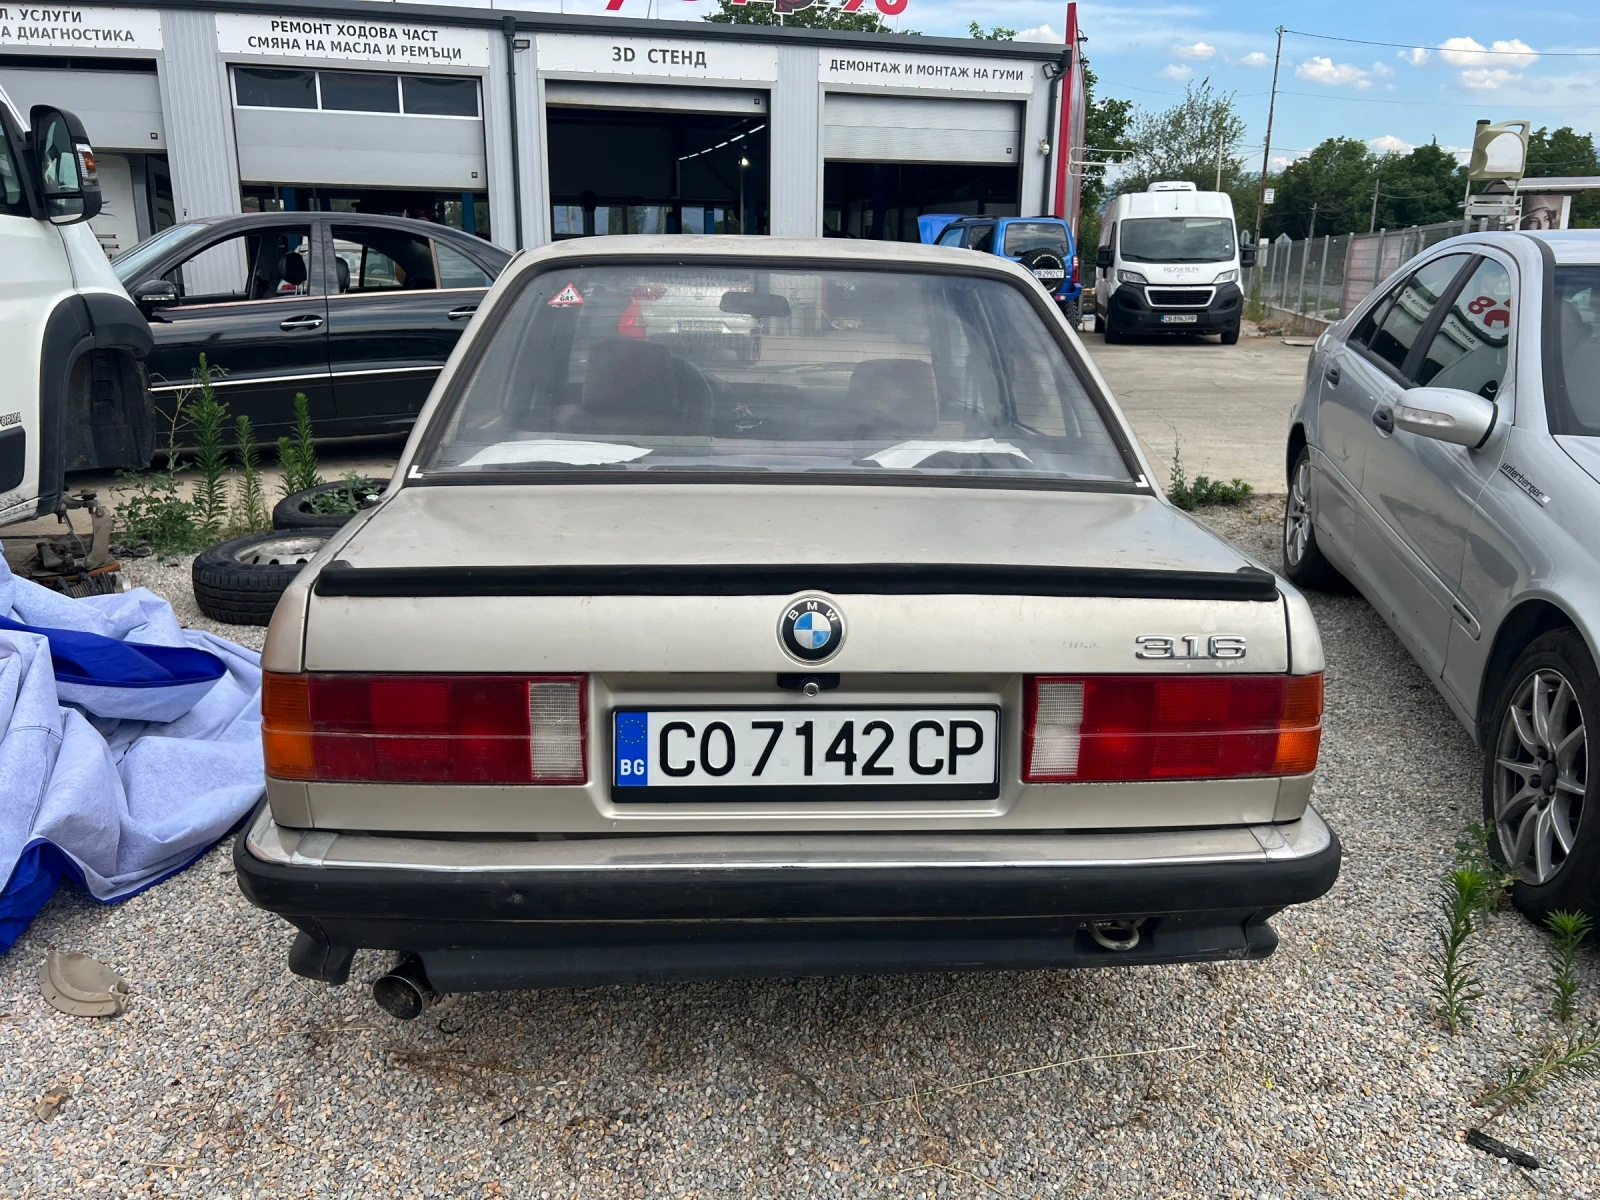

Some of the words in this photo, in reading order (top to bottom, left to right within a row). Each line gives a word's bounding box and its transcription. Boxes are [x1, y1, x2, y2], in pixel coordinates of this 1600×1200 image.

[19, 9, 82, 23] УСЛУГИ
[17, 26, 135, 42] ДИАГНОСТИКА
[270, 20, 332, 35] РЕМОНТ
[337, 24, 398, 40] ХОДОВА
[402, 28, 438, 42] ЧАСТ
[247, 36, 301, 50] СМЯНА
[305, 39, 326, 51] НА
[330, 41, 382, 55] МАСЛА
[386, 44, 396, 55] И
[401, 45, 462, 60] РЕМЪЦИ
[612, 46, 636, 62] 3D
[647, 48, 707, 69] СТЕНД
[829, 59, 901, 74] ДЕМОНТАЖ
[904, 64, 913, 75] И
[916, 64, 970, 78] МОНТАЖ
[973, 67, 989, 79] НА
[992, 69, 1024, 81] ГУМИ
[0, 411, 22, 427] ORMA
[1501, 462, 1544, 498] unterberger
[788, 601, 838, 621] BMW
[1135, 634, 1247, 660] 316
[619, 759, 646, 777] BG
